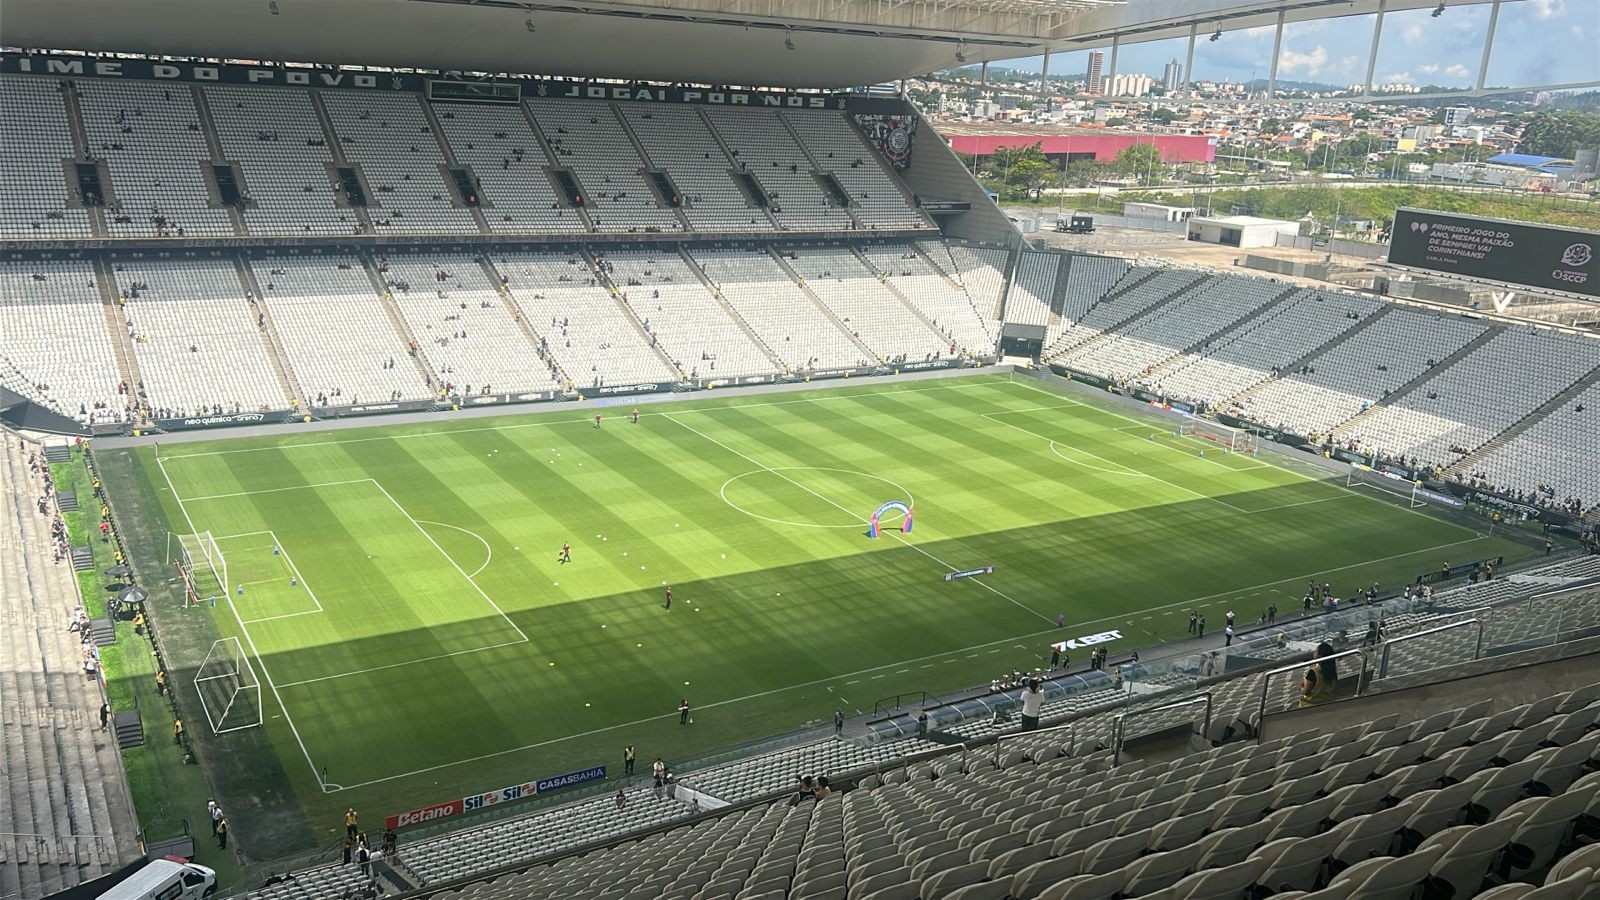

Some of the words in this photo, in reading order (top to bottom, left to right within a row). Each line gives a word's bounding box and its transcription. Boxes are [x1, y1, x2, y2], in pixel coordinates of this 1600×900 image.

[0, 57, 122, 76] IME
[153, 64, 219, 80] DO
[248, 69, 376, 88] POVO
[565, 85, 666, 101] JOGAI
[684, 91, 749, 105] POR
[1431, 223, 1470, 234] PRIMEIRO
[1471, 228, 1495, 237] JOGO
[1495, 231, 1510, 239] DO
[1428, 237, 1441, 245] DE
[1477, 244, 1492, 252] VAI
[1430, 231, 1449, 239] ANO,
[1451, 233, 1480, 243] MESMA
[1481, 237, 1514, 248] PAIXÃO
[1427, 245, 1486, 259] CORINTHIANS!
[1562, 273, 1587, 283] SCCP
[503, 786, 522, 801] Sil
[464, 795, 484, 810] Sil
[397, 805, 454, 828] Betano
